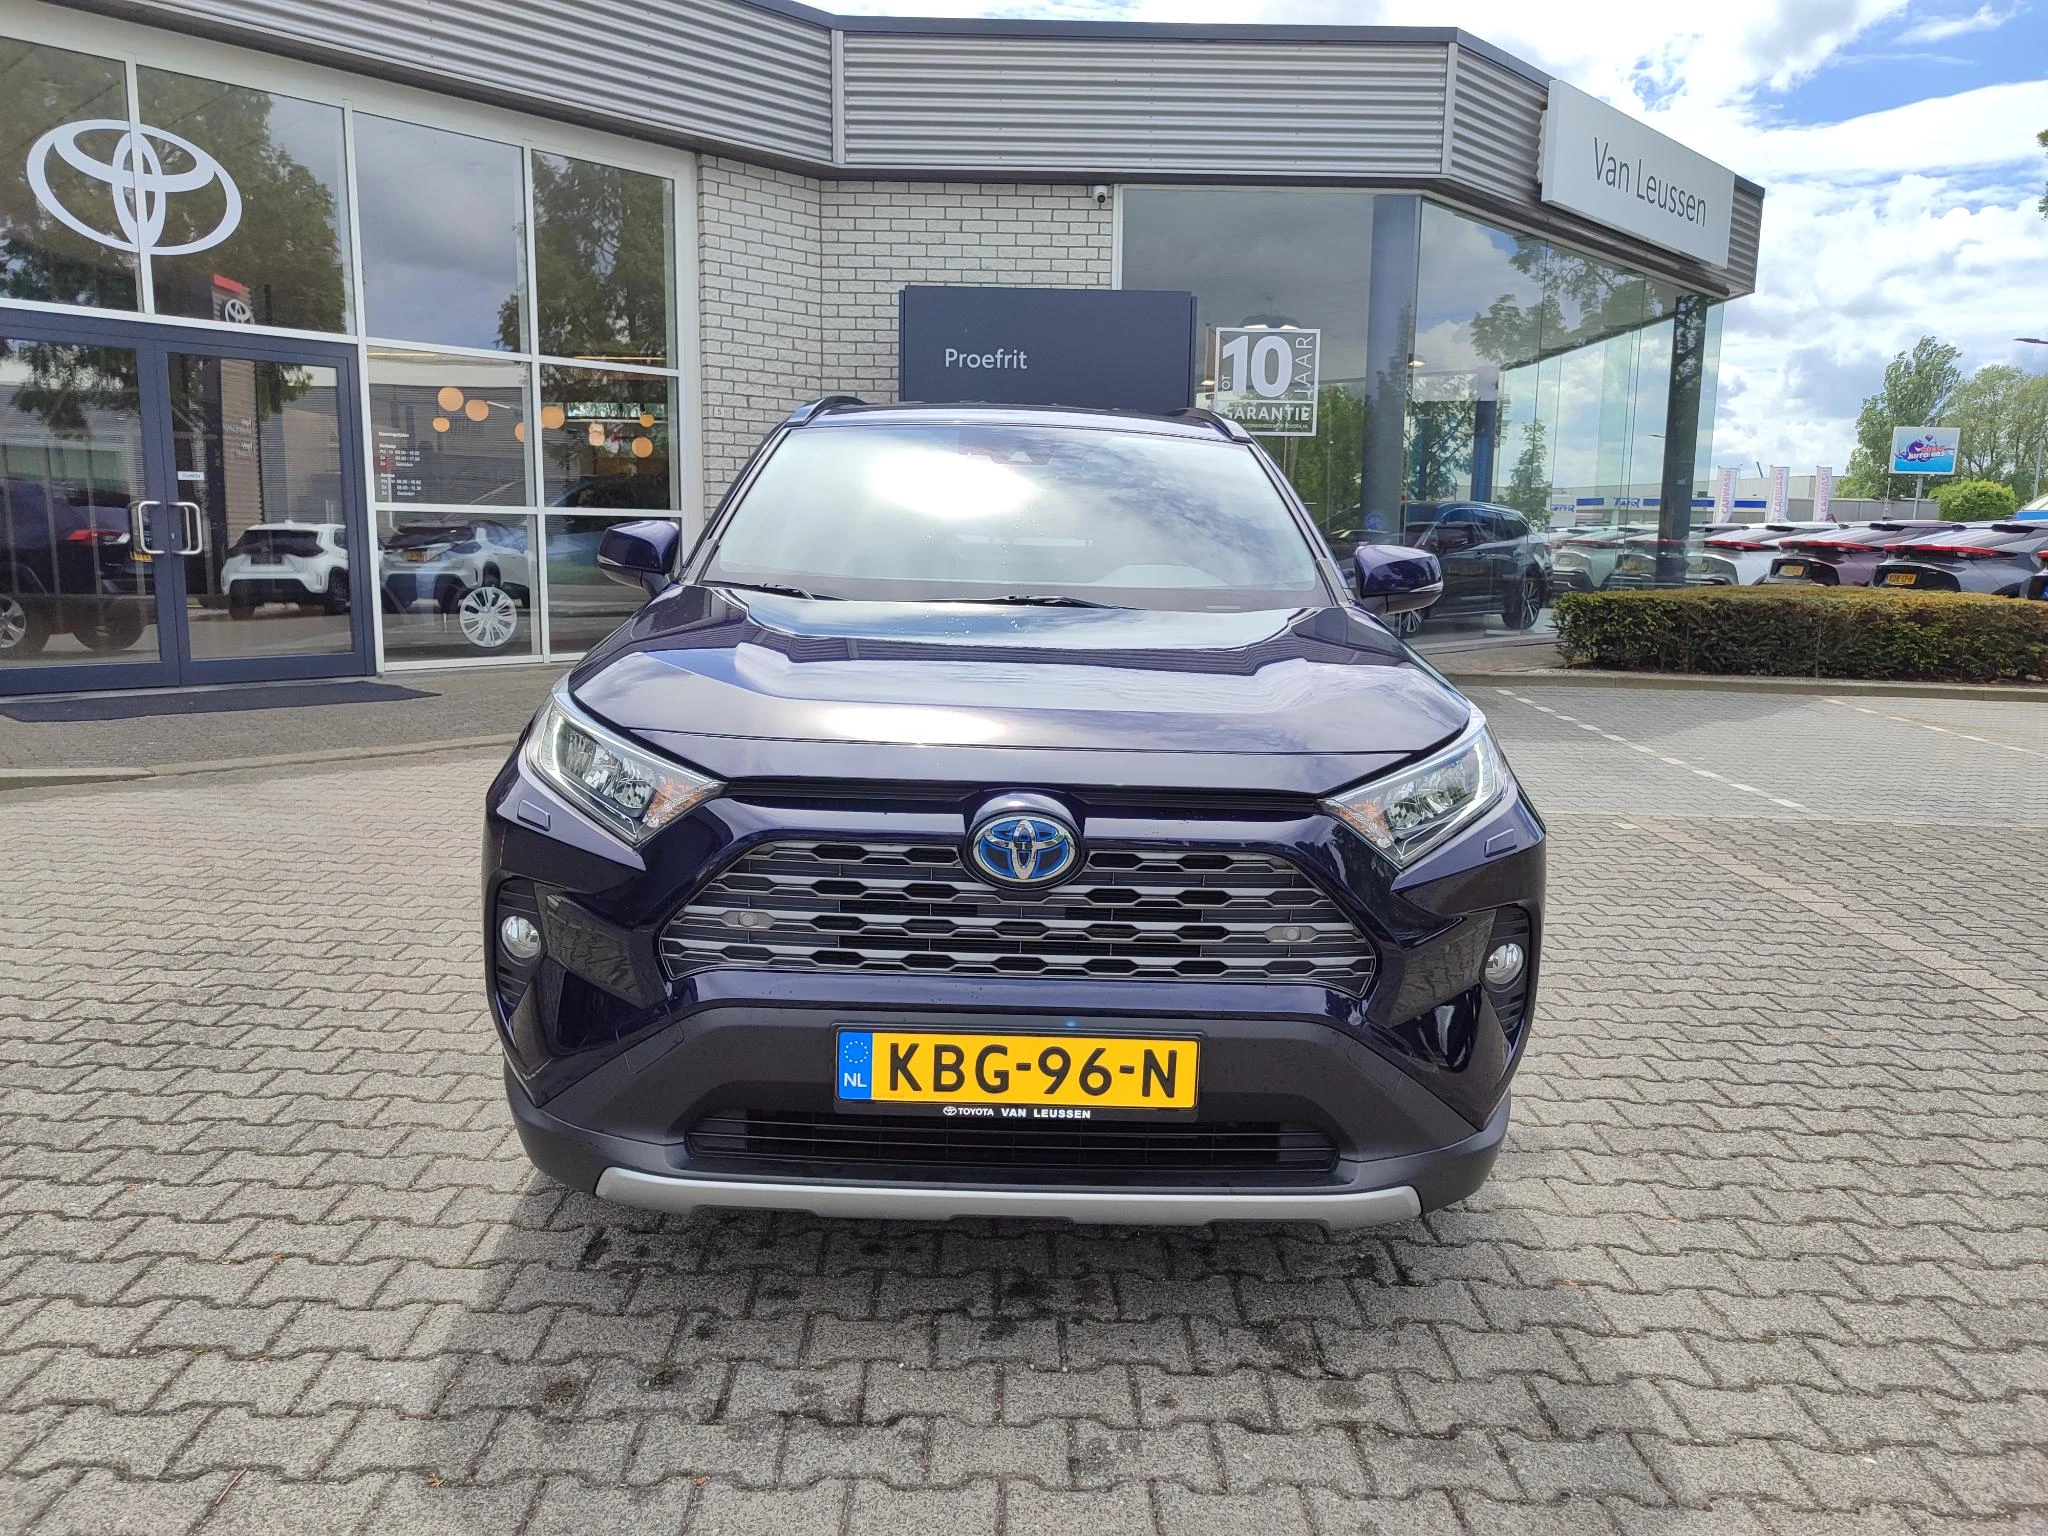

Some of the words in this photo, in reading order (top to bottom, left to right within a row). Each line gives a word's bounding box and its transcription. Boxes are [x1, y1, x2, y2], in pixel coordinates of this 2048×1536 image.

[1594, 136, 1630, 193] Van
[1636, 158, 1706, 227] Leussen
[945, 347, 1028, 369] Proefrit
[1222, 335, 1293, 397] 10
[1721, 470, 1732, 514] CARWASH
[1774, 469, 1784, 513] CARWASH
[1820, 469, 1831, 513] CARWASH
[843, 1072, 867, 1088] NL
[888, 1042, 1178, 1099] KBG-96-N
[958, 1107, 994, 1117] TOYOTA
[1001, 1108, 1027, 1118] VAN
[1033, 1108, 1091, 1119] LEUSSEN
